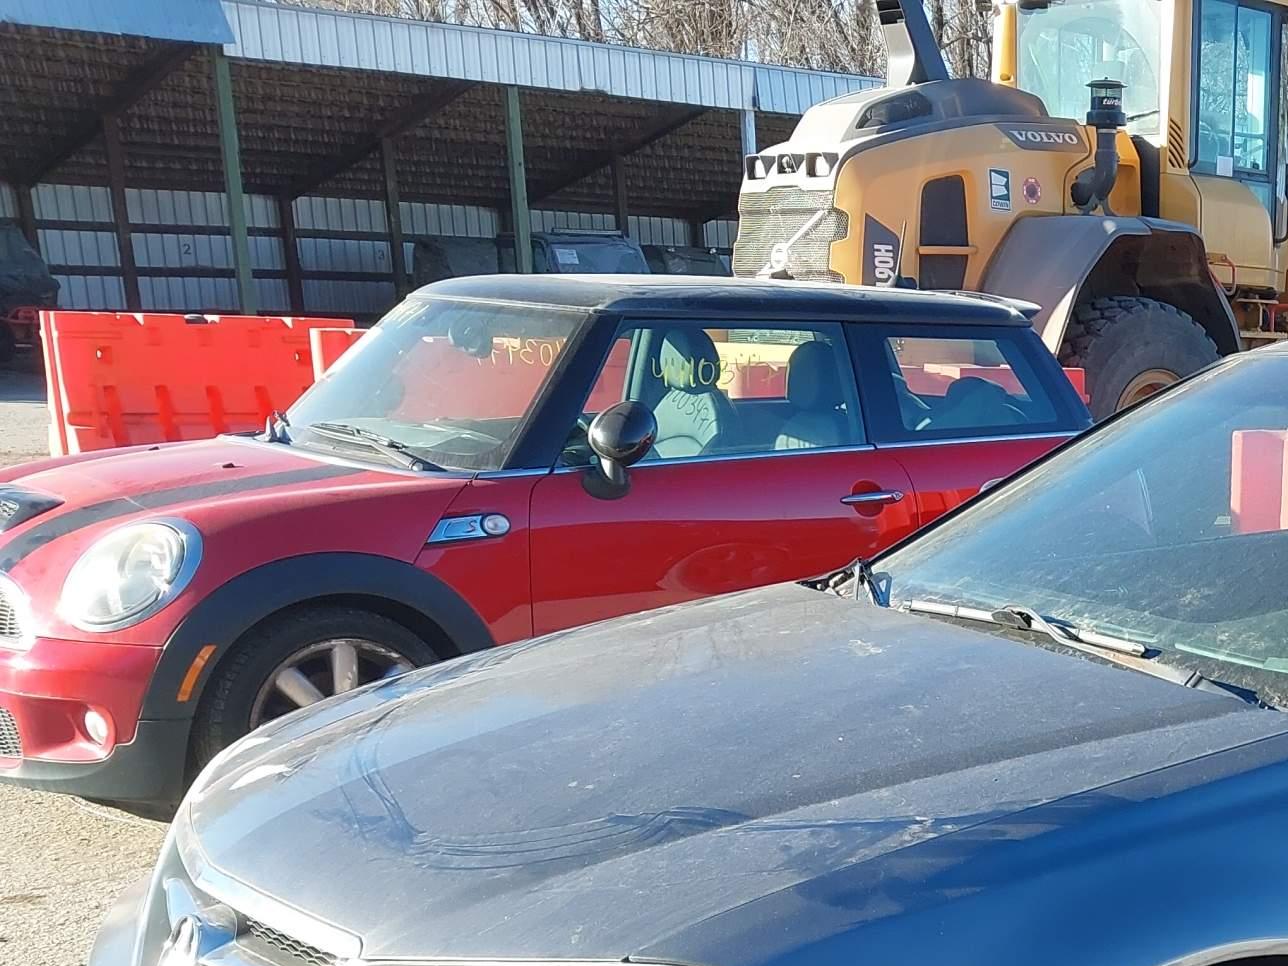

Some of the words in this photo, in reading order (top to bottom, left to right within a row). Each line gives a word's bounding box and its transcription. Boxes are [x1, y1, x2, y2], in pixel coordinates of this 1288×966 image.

[1010, 130, 1078, 145] VOLVO
[183, 243, 192, 255] 2
[377, 249, 384, 261] 3
